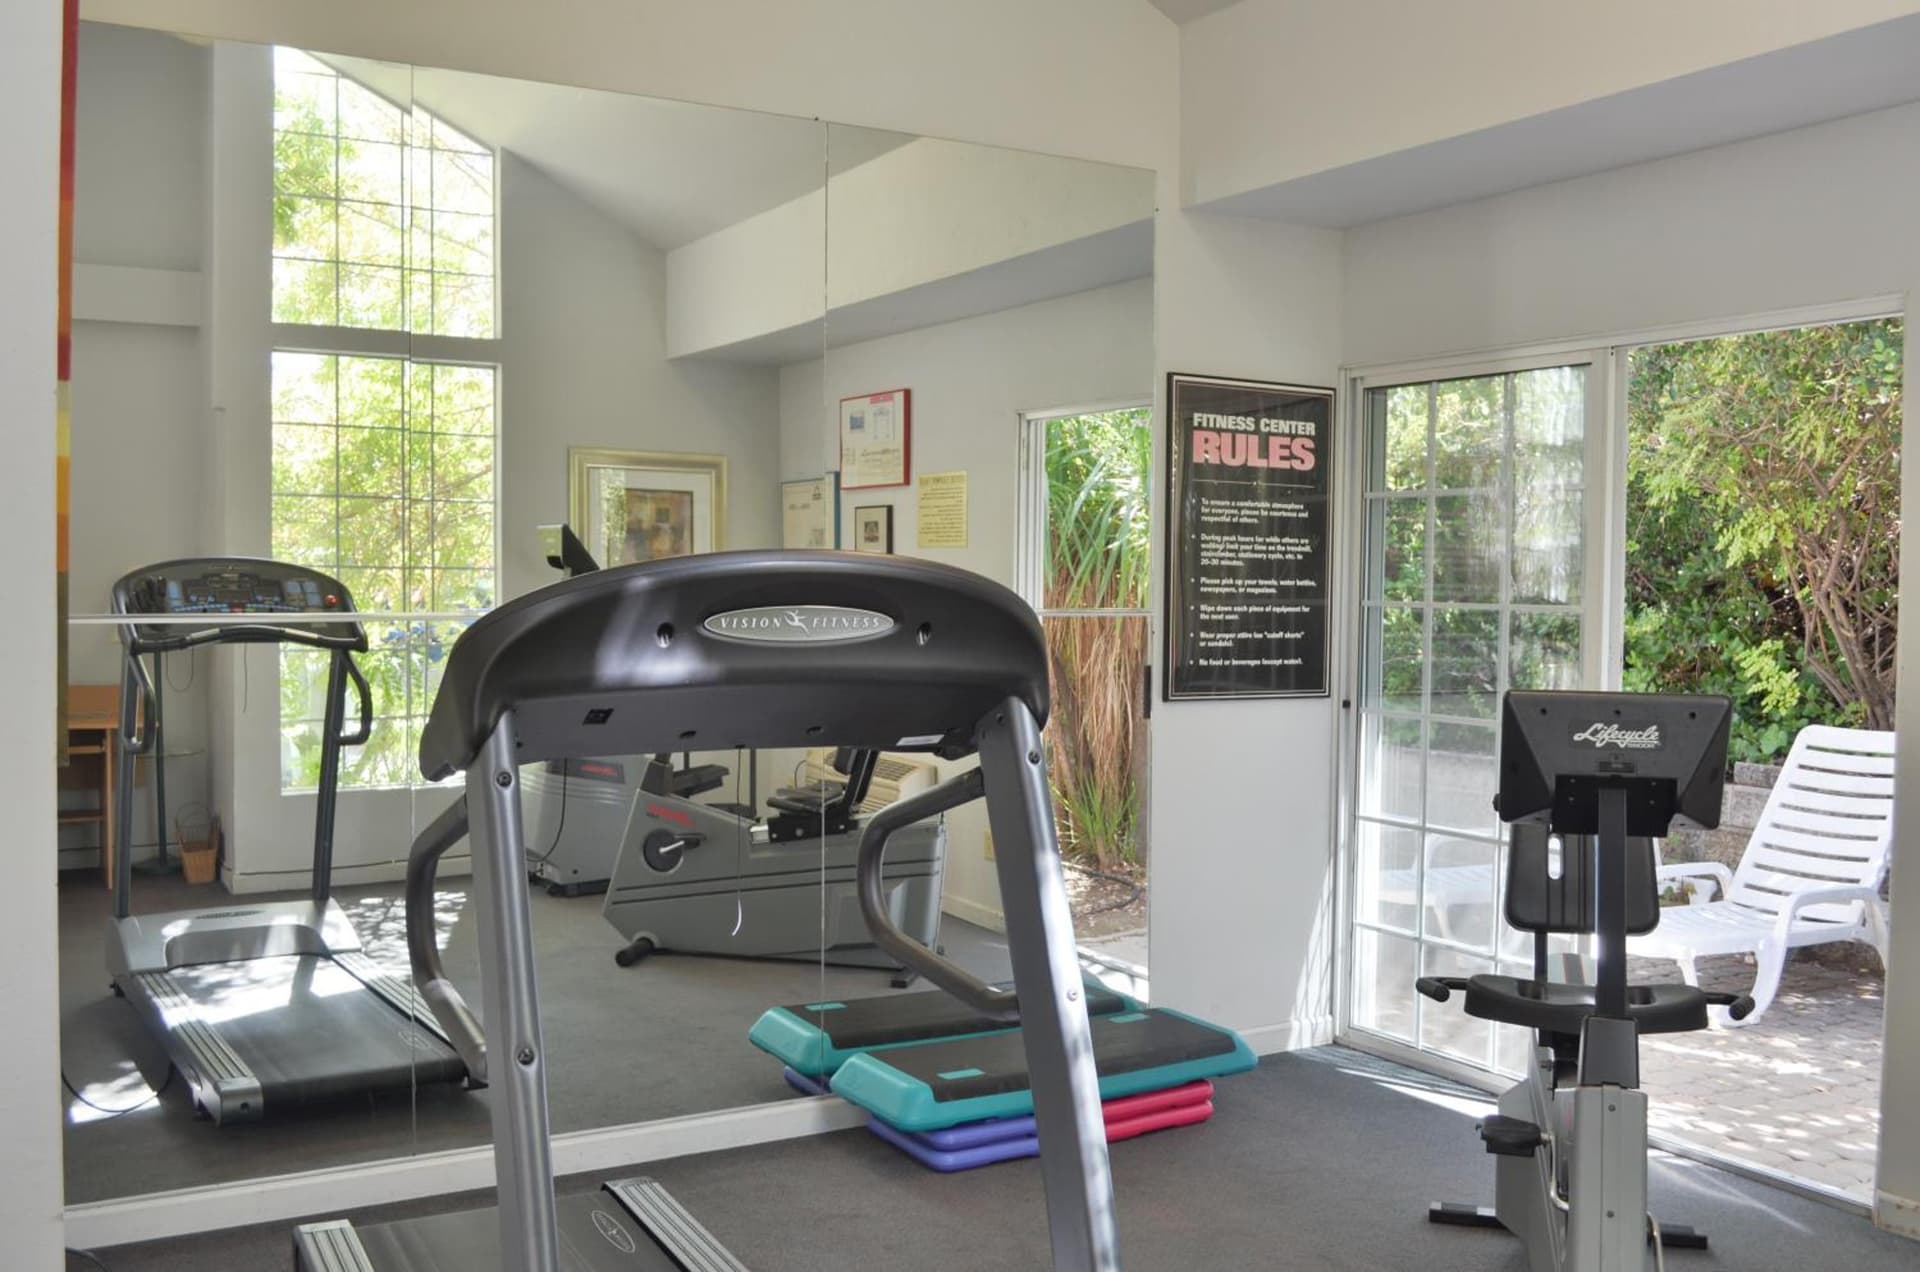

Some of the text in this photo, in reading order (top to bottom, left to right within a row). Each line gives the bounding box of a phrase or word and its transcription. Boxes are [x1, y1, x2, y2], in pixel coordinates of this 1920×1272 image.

[1193, 412, 1316, 436] FITNESS CENTER
[1192, 430, 1316, 471] RULES
[720, 616, 881, 629] VISION FITNESS
[1572, 722, 1660, 749] Lifecycle
